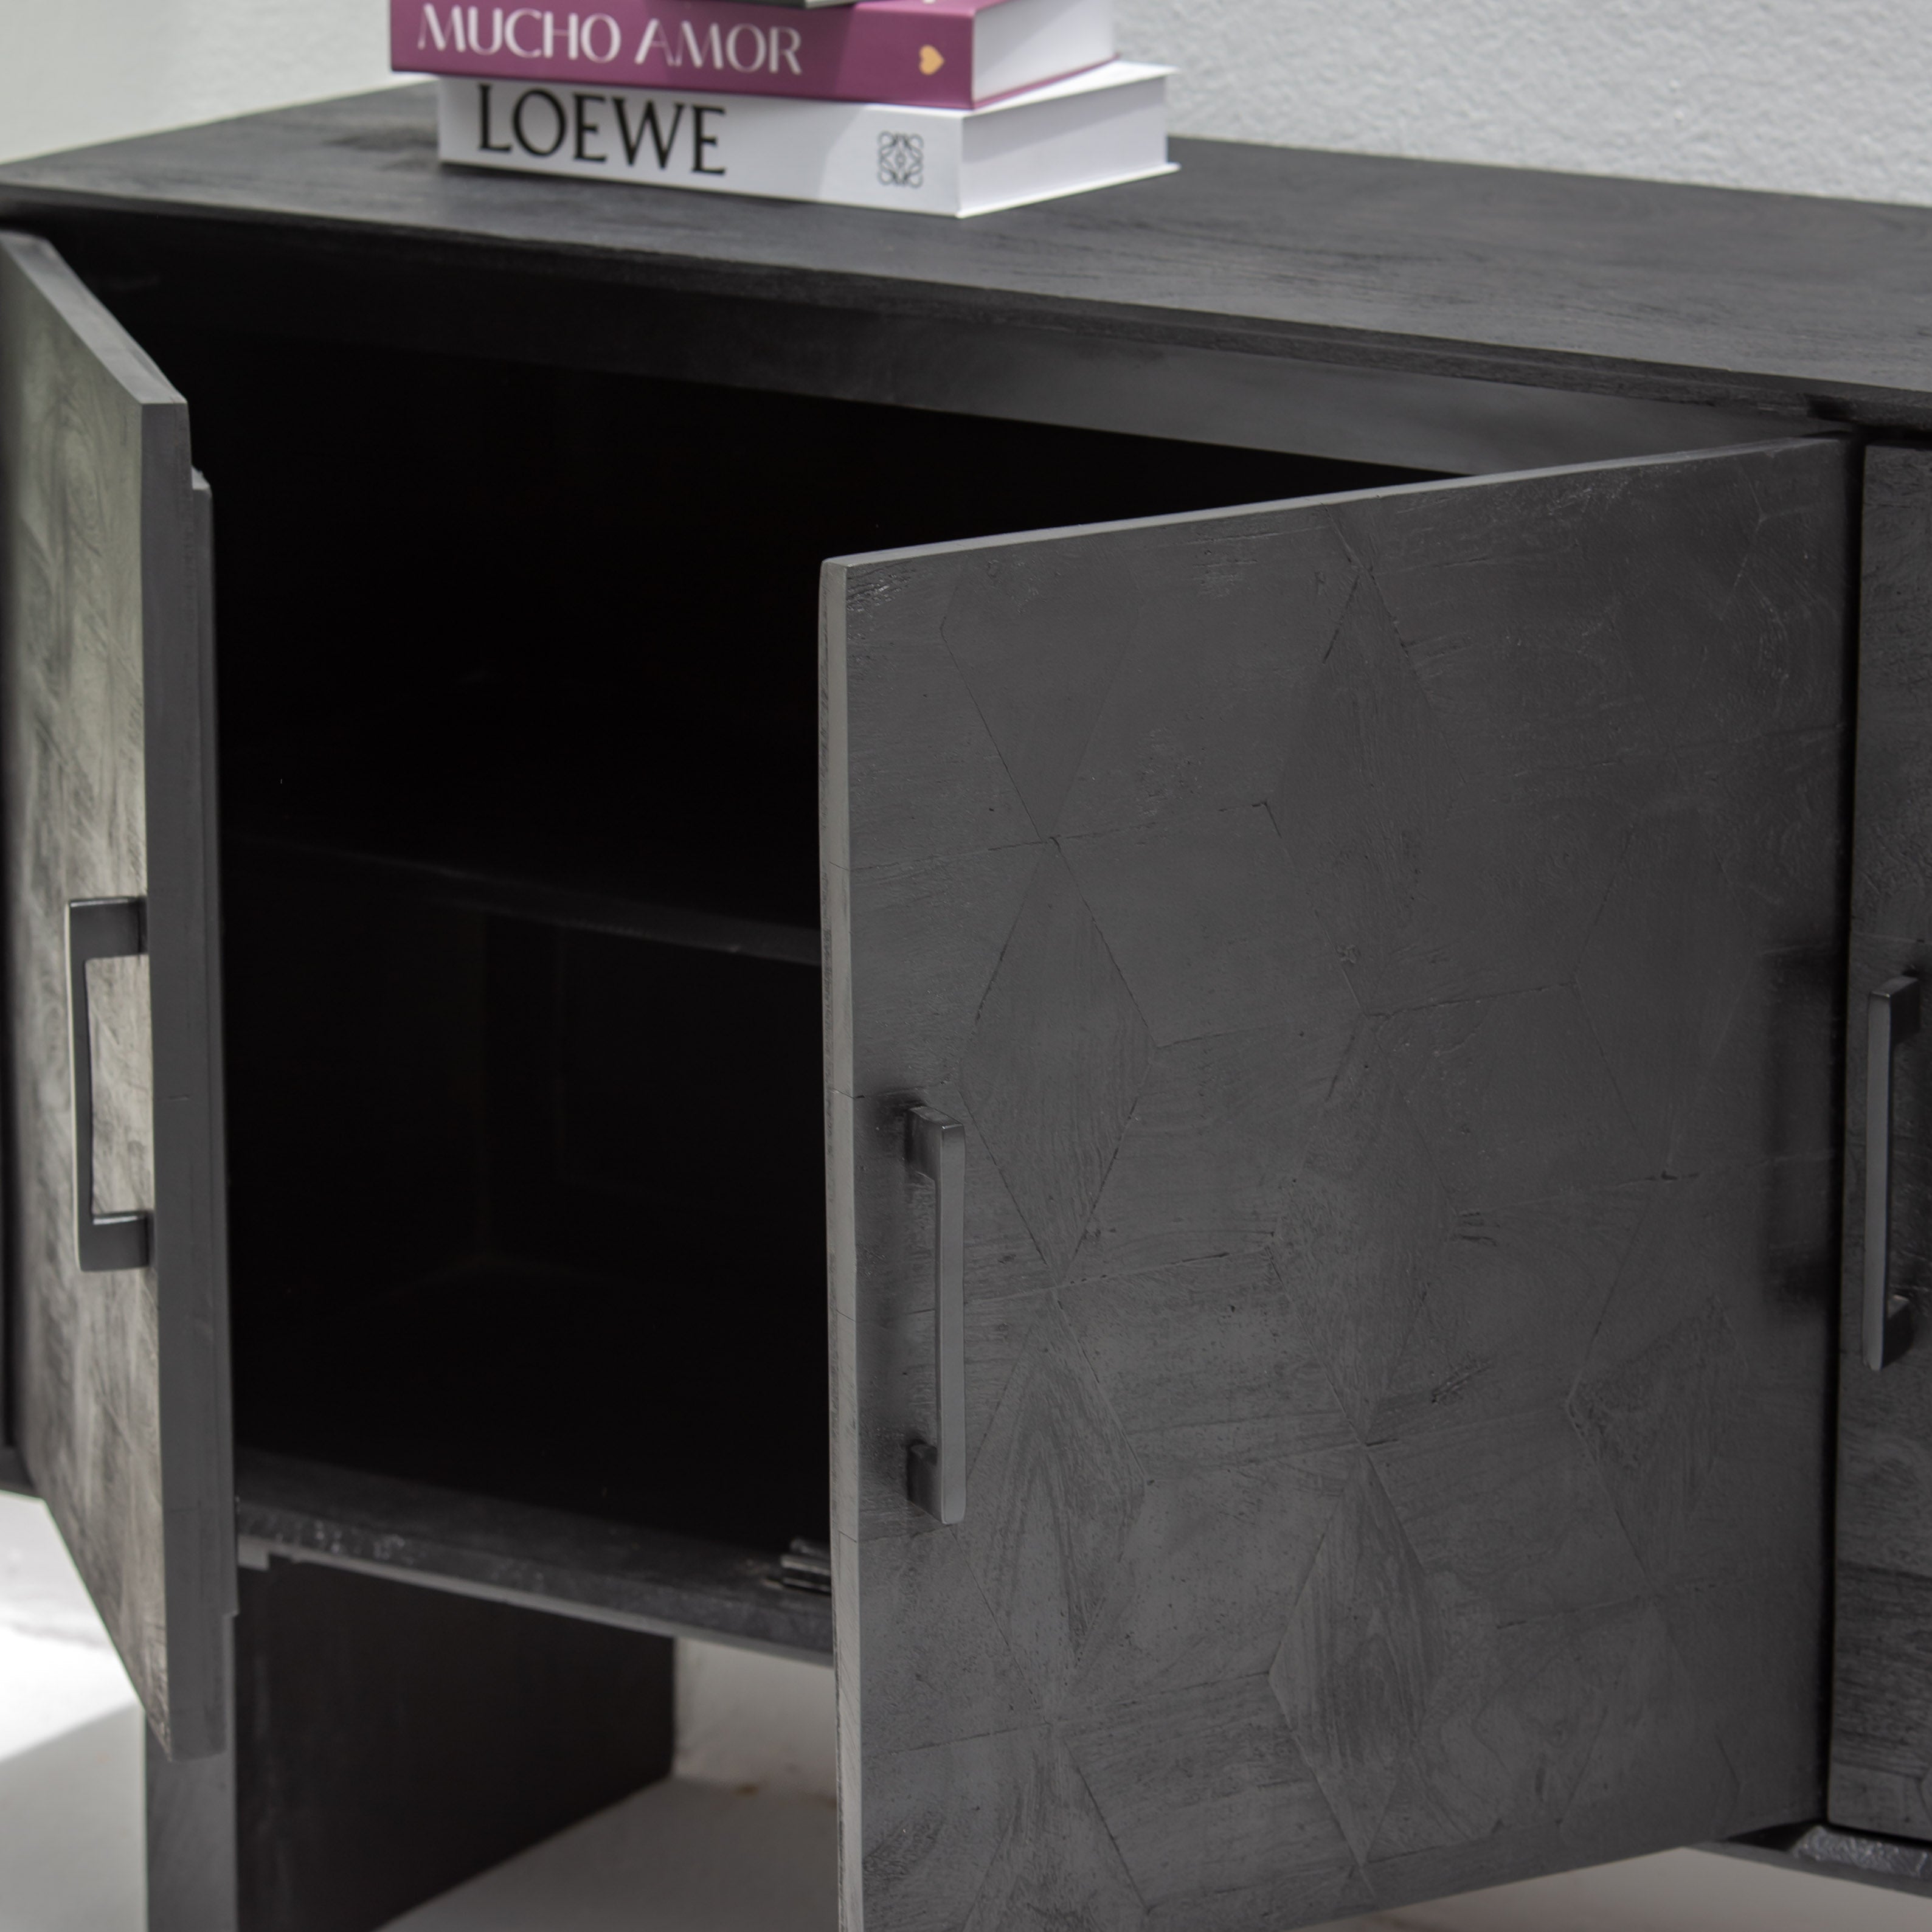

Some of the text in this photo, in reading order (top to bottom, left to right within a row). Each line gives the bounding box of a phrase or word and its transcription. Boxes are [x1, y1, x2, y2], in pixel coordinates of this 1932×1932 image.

[417, 3, 802, 75] MUCHO AMOR
[478, 83, 726, 175] LOEWE
